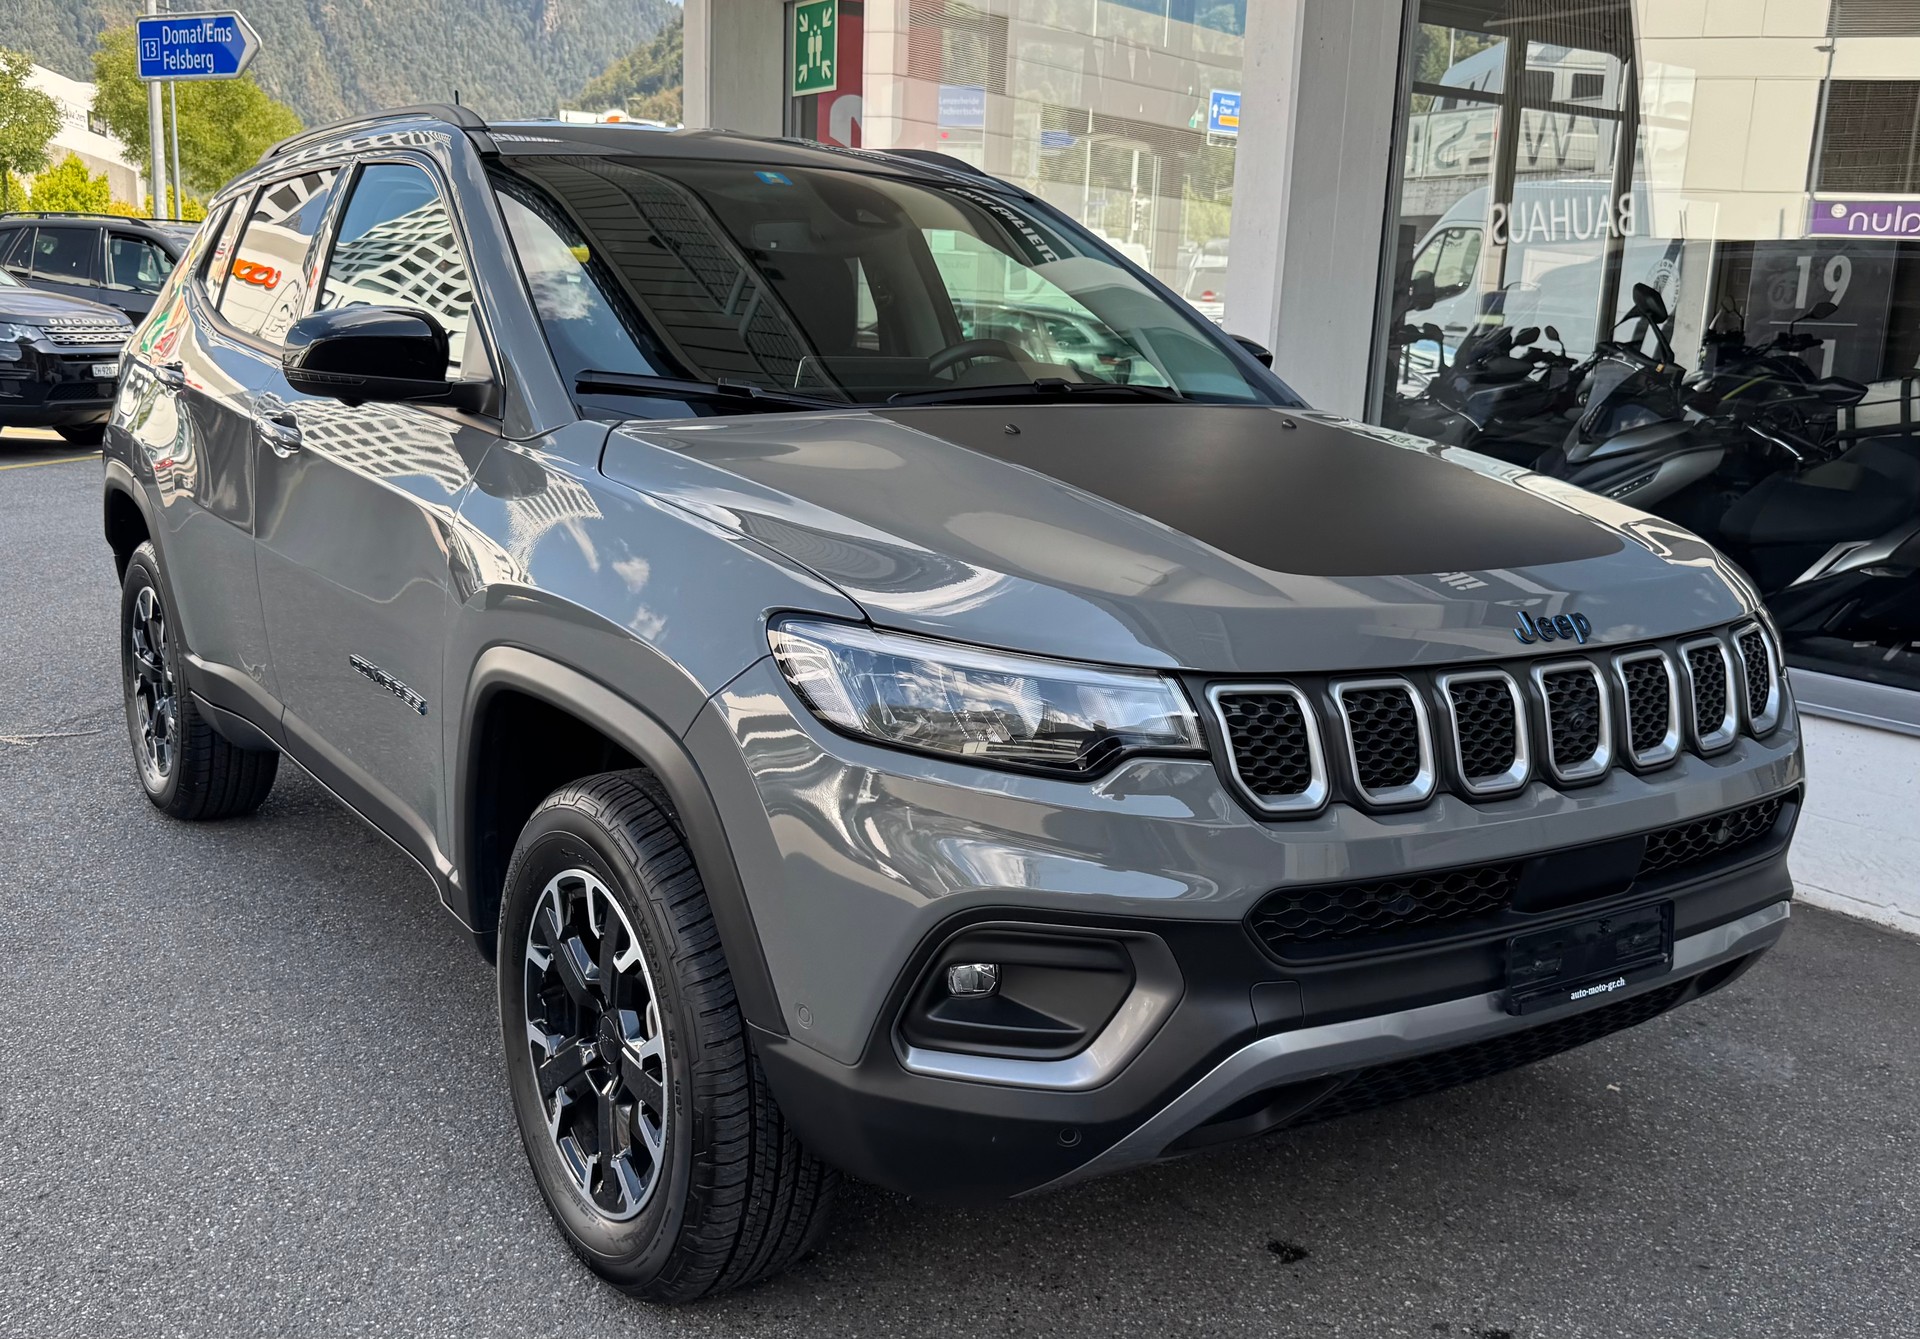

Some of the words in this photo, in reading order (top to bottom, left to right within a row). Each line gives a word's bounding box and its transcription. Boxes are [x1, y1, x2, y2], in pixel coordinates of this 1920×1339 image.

[162, 23, 232, 45] Domat/Ems
[145, 41, 157, 58] 13
[163, 48, 214, 74] Felsberg
[1795, 255, 1852, 310] 19
[1513, 611, 1592, 645] Jeep
[1570, 977, 1626, 1000] auto-moto-gr.ch
